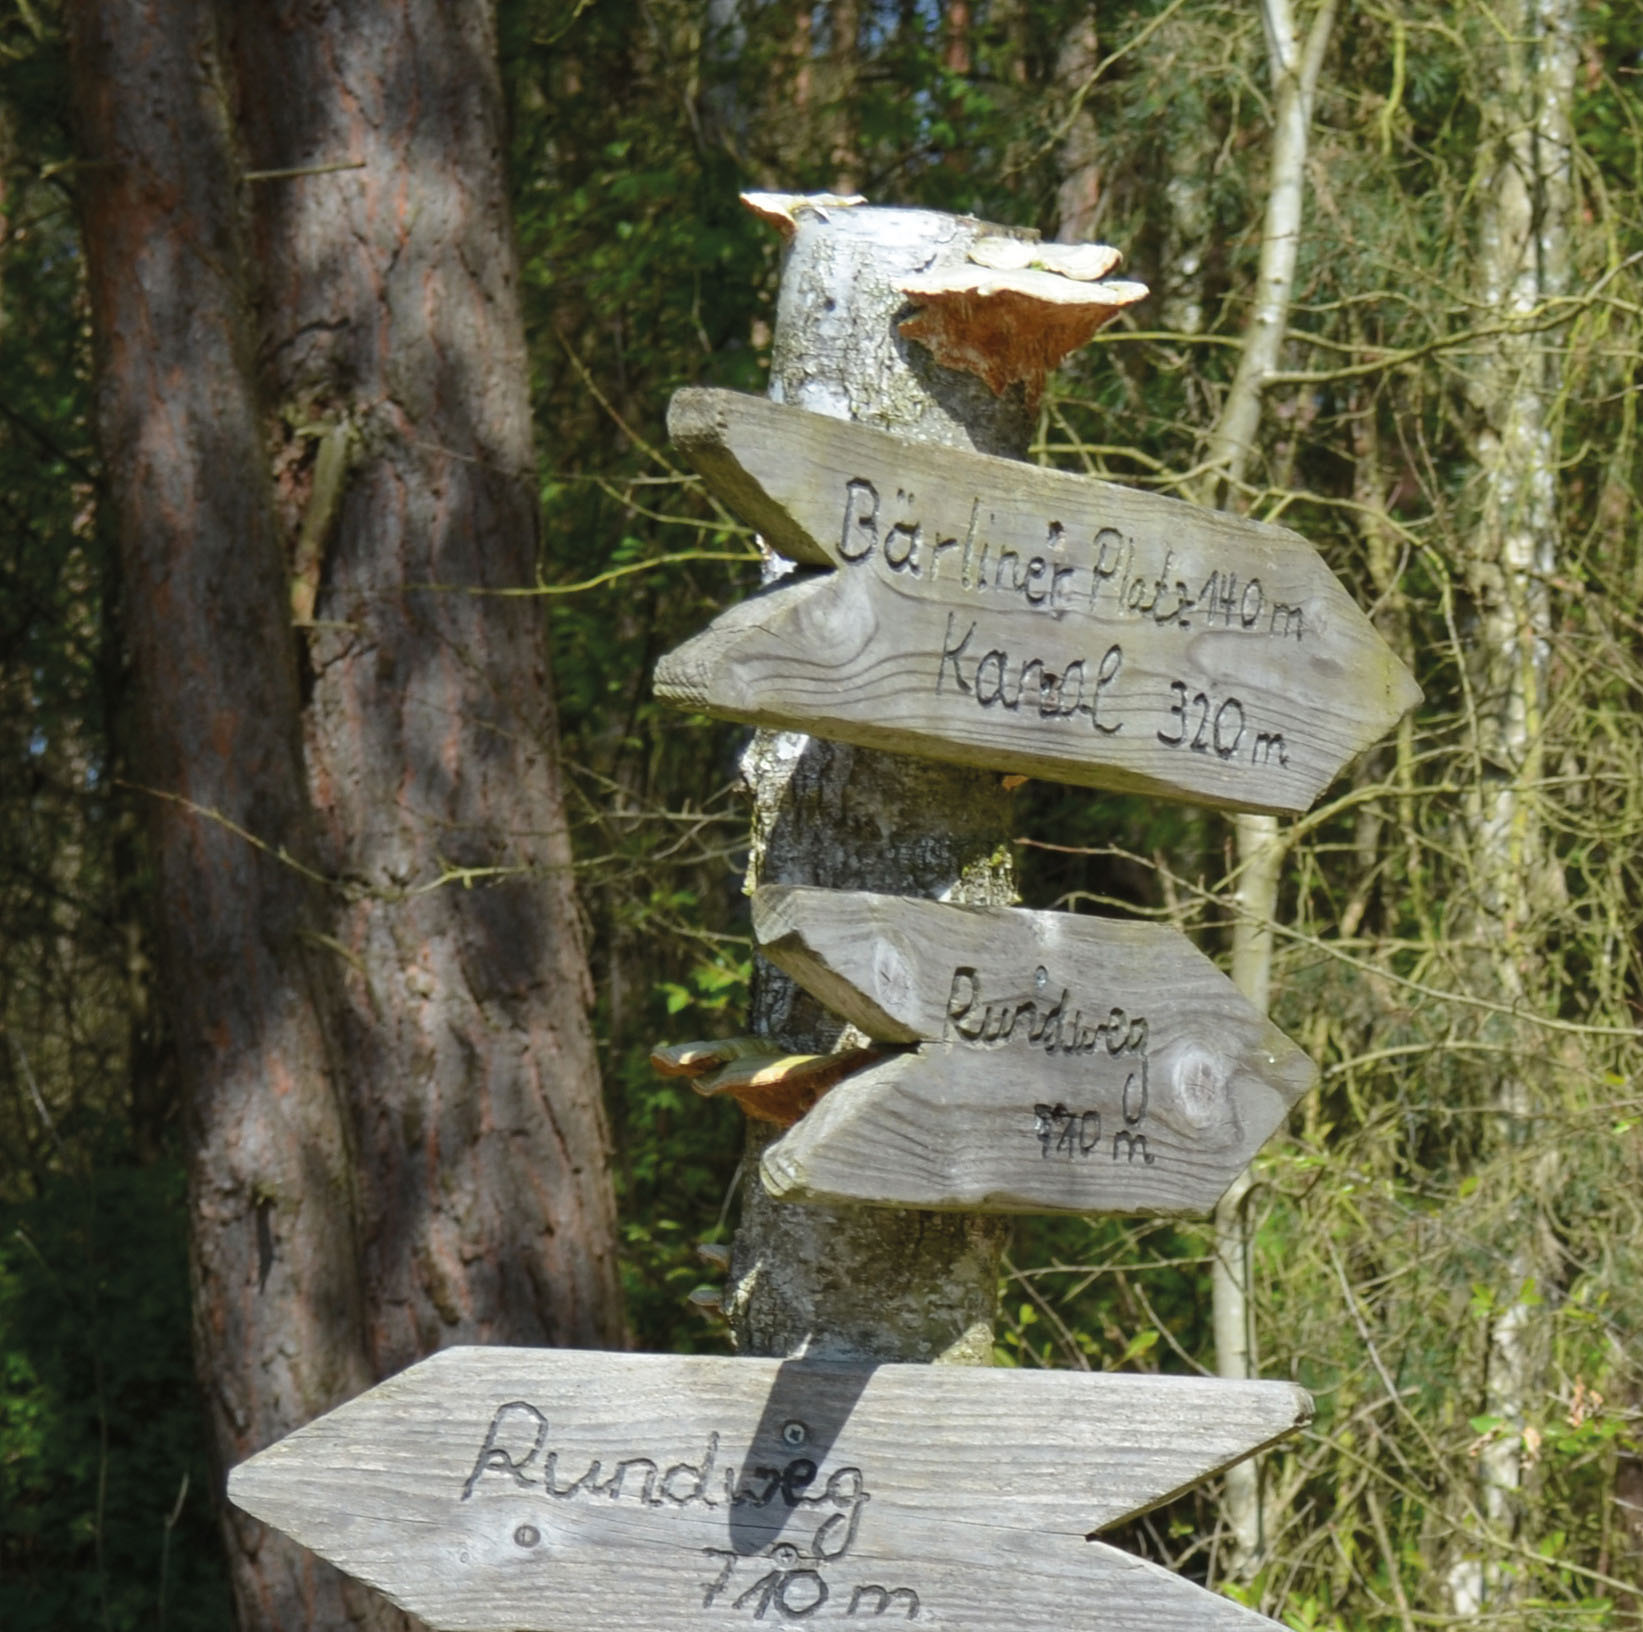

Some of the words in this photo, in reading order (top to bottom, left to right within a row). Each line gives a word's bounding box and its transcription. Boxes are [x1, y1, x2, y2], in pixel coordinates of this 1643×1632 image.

[1089, 526, 1196, 628] Platz
[1200, 569, 1265, 629] 140
[1270, 602, 1304, 641] m
[1156, 679, 1247, 760] 320
[1251, 731, 1290, 768] m
[944, 966, 1150, 1126] Rundweg
[1112, 1130, 1155, 1164] m
[461, 1401, 872, 1562] Rundweg
[700, 1547, 830, 1621] 710
[846, 1584, 921, 1621] m
